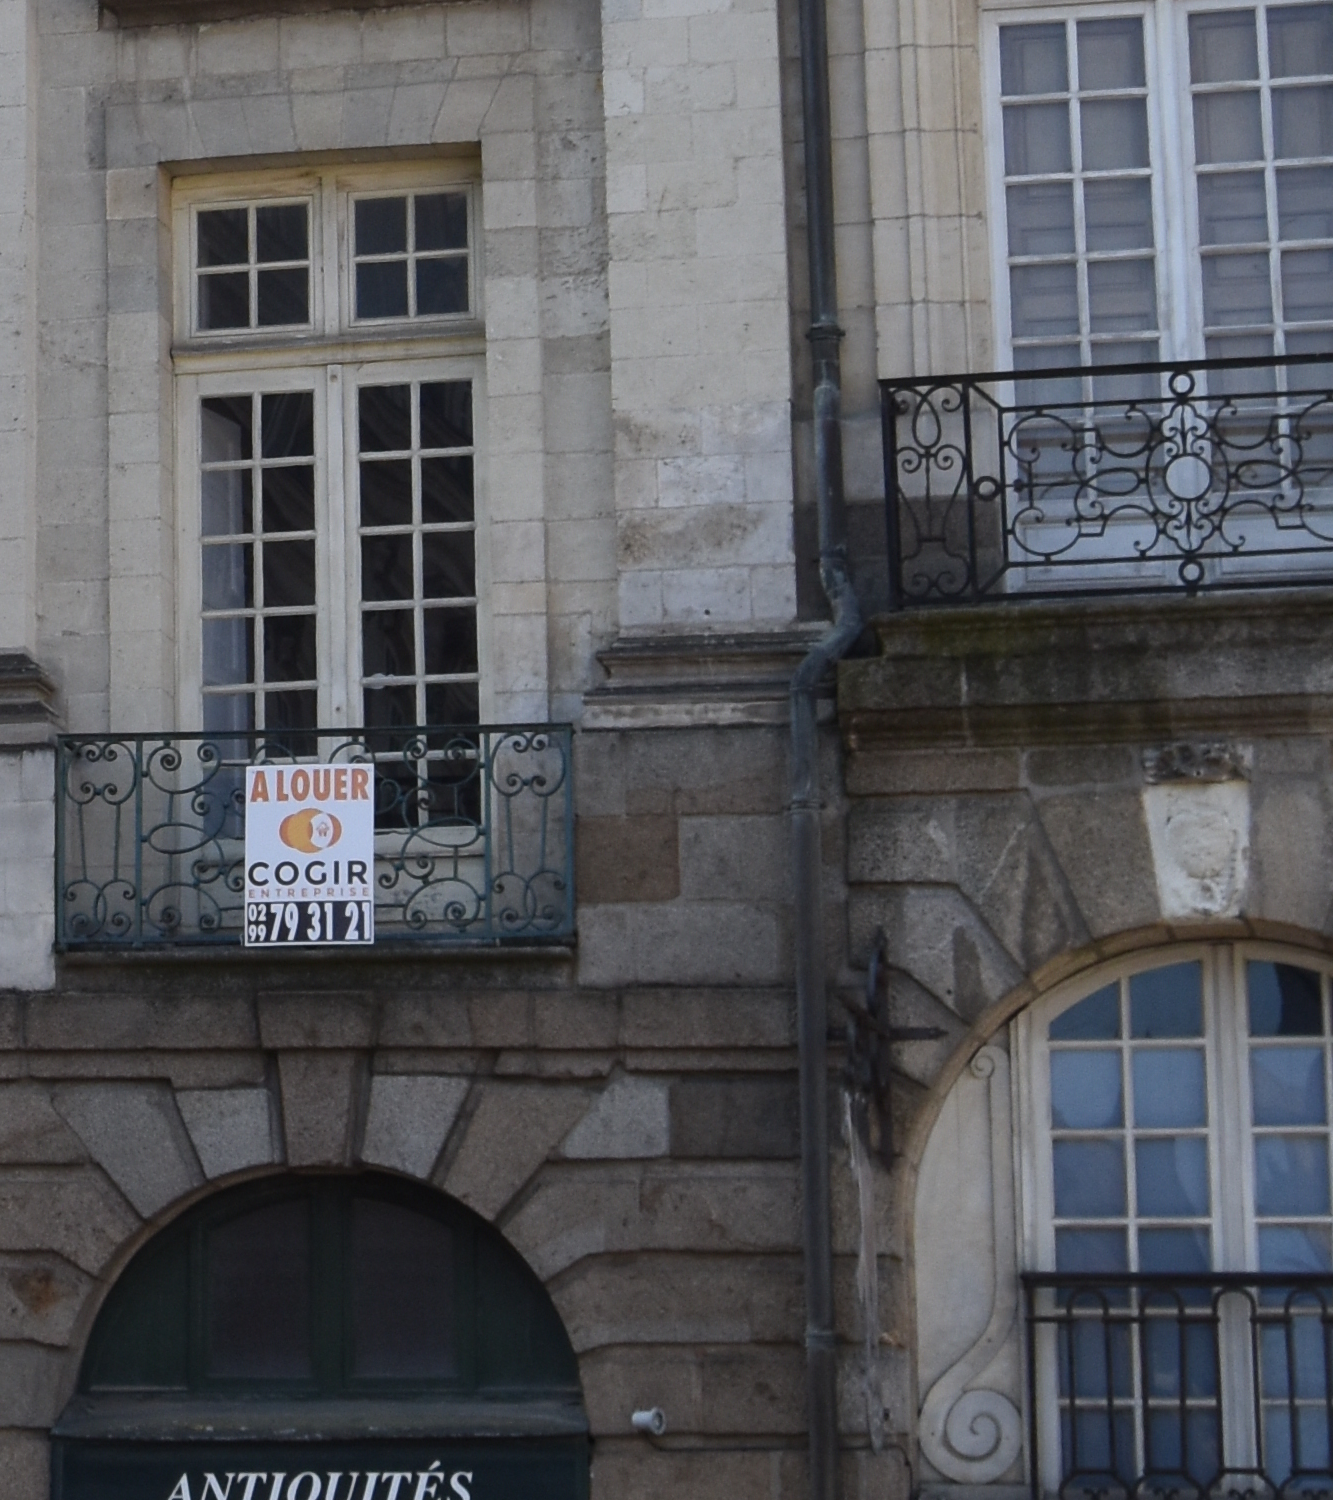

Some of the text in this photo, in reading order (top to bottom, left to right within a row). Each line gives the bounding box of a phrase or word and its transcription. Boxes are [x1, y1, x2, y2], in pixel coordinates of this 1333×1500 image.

[250, 768, 369, 802] A LOUER
[247, 860, 368, 887] COGIR
[247, 887, 370, 899] ENTREPRISE
[248, 902, 371, 941] 02 79 31 21
[248, 924, 267, 942] 99
